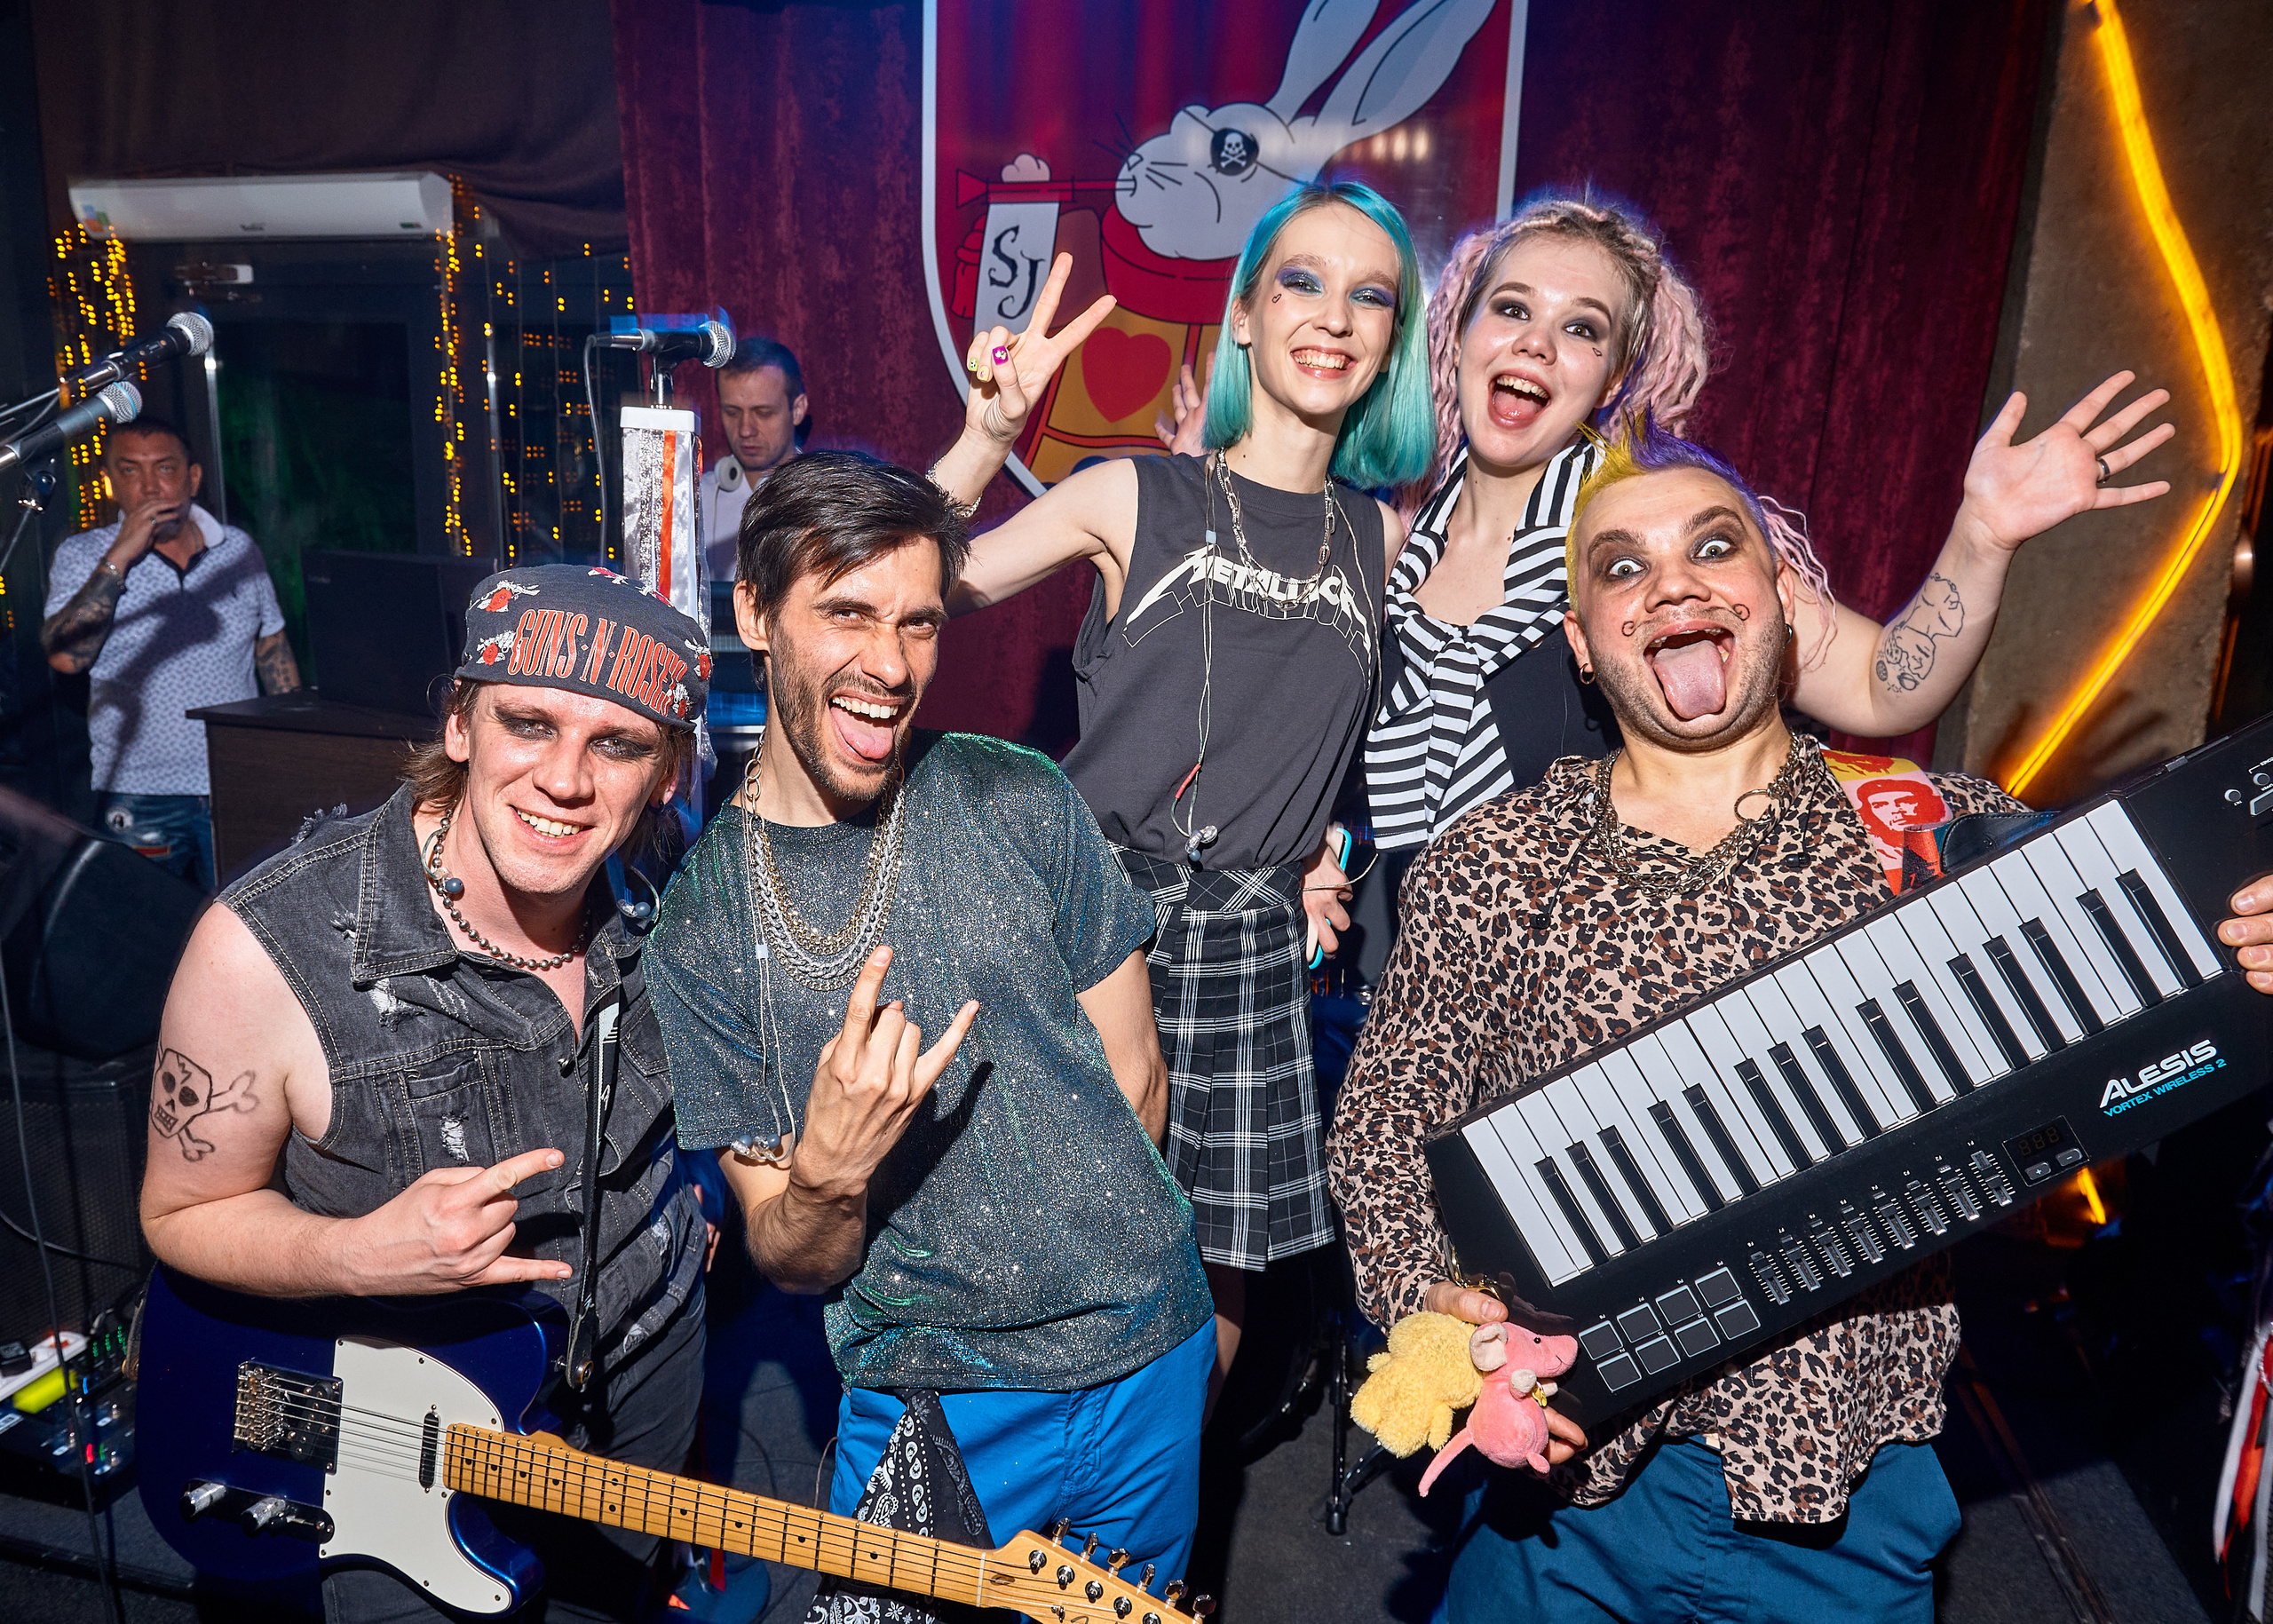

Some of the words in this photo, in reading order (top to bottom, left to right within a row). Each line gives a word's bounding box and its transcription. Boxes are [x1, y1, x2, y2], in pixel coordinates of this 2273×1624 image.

[2099, 1039, 2218, 1108] ALESIS
[2103, 1090, 2153, 1117] VORTEX
[2152, 1064, 2215, 1096] WIRELESS
[2214, 1058, 2227, 1068] 2
